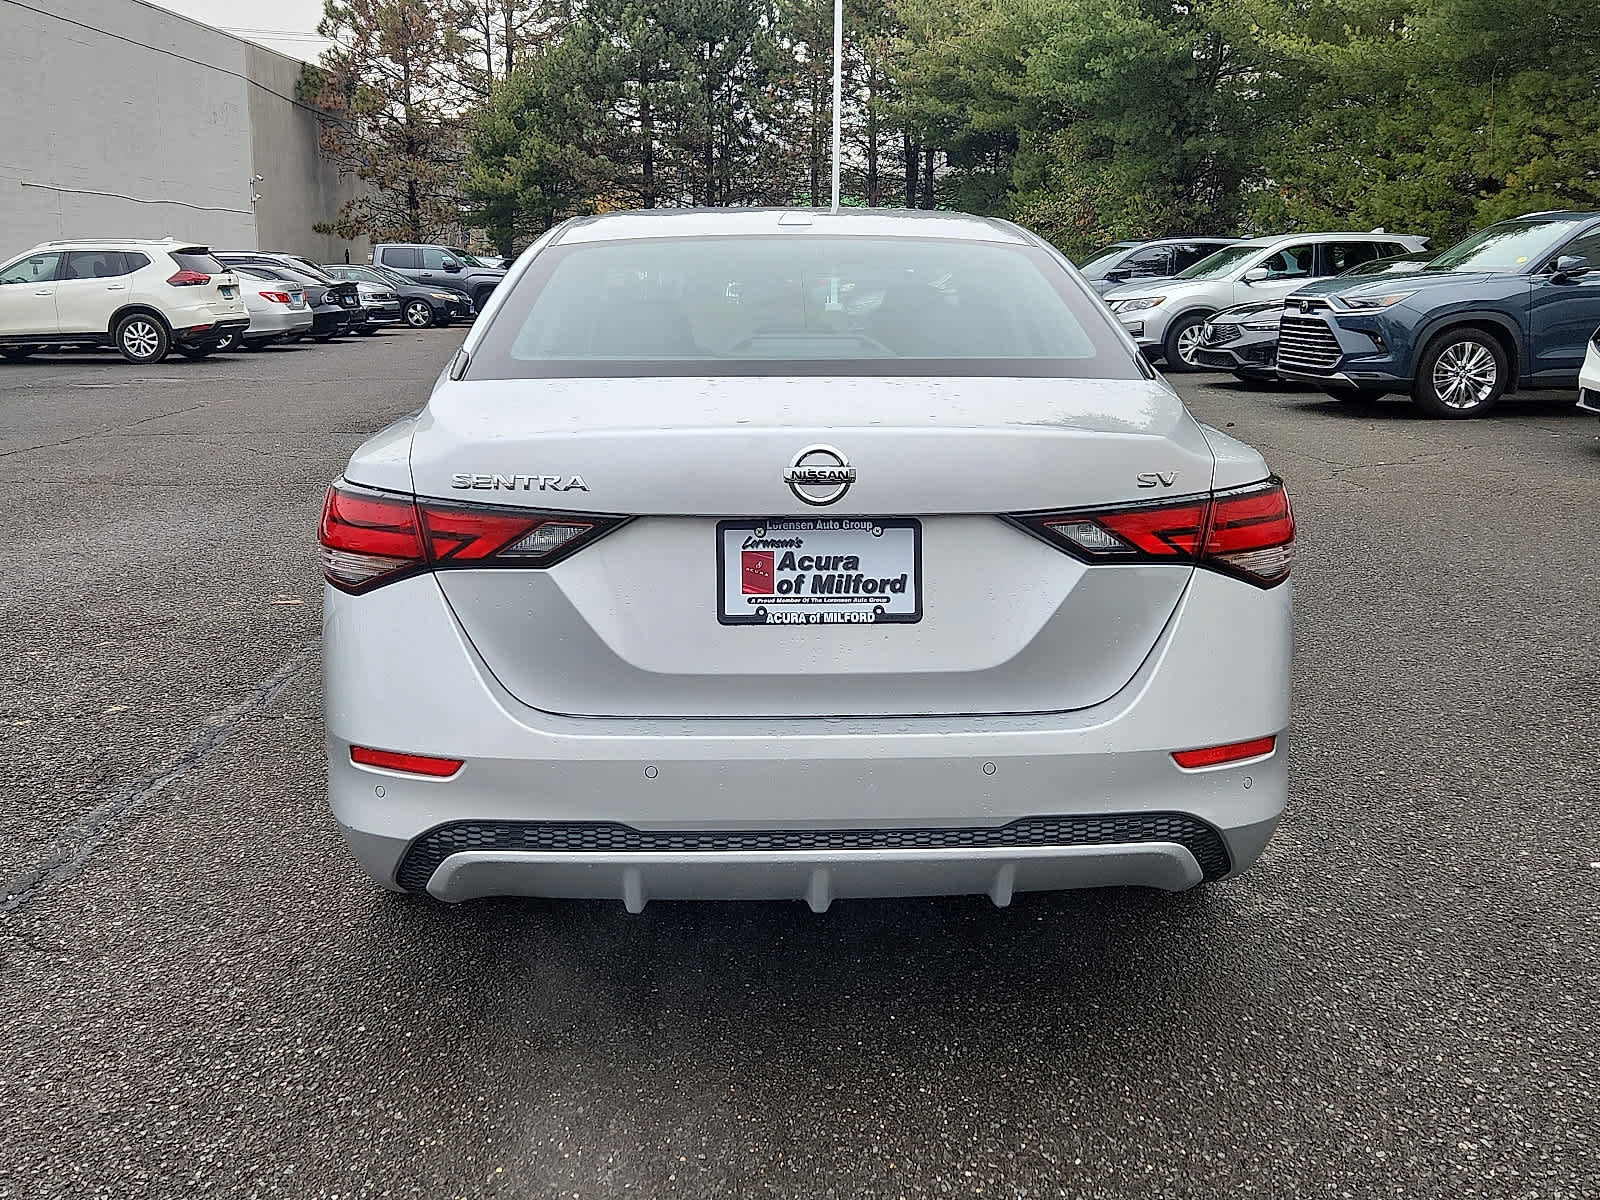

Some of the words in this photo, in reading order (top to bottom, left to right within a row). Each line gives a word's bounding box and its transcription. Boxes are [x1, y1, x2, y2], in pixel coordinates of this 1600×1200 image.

[451, 473, 591, 491] SENTRA
[791, 470, 849, 480] NISSAN
[1136, 471, 1178, 488] SV
[766, 520, 814, 530] Lorensen
[816, 520, 840, 530] Auto
[842, 520, 873, 532] Group
[742, 536, 804, 550] Lorensen's
[777, 551, 860, 571] Acura
[777, 574, 805, 595] of
[811, 574, 908, 595] Milford
[766, 612, 806, 623] ACURA
[809, 612, 821, 623] of
[824, 612, 875, 623] MILFORD
